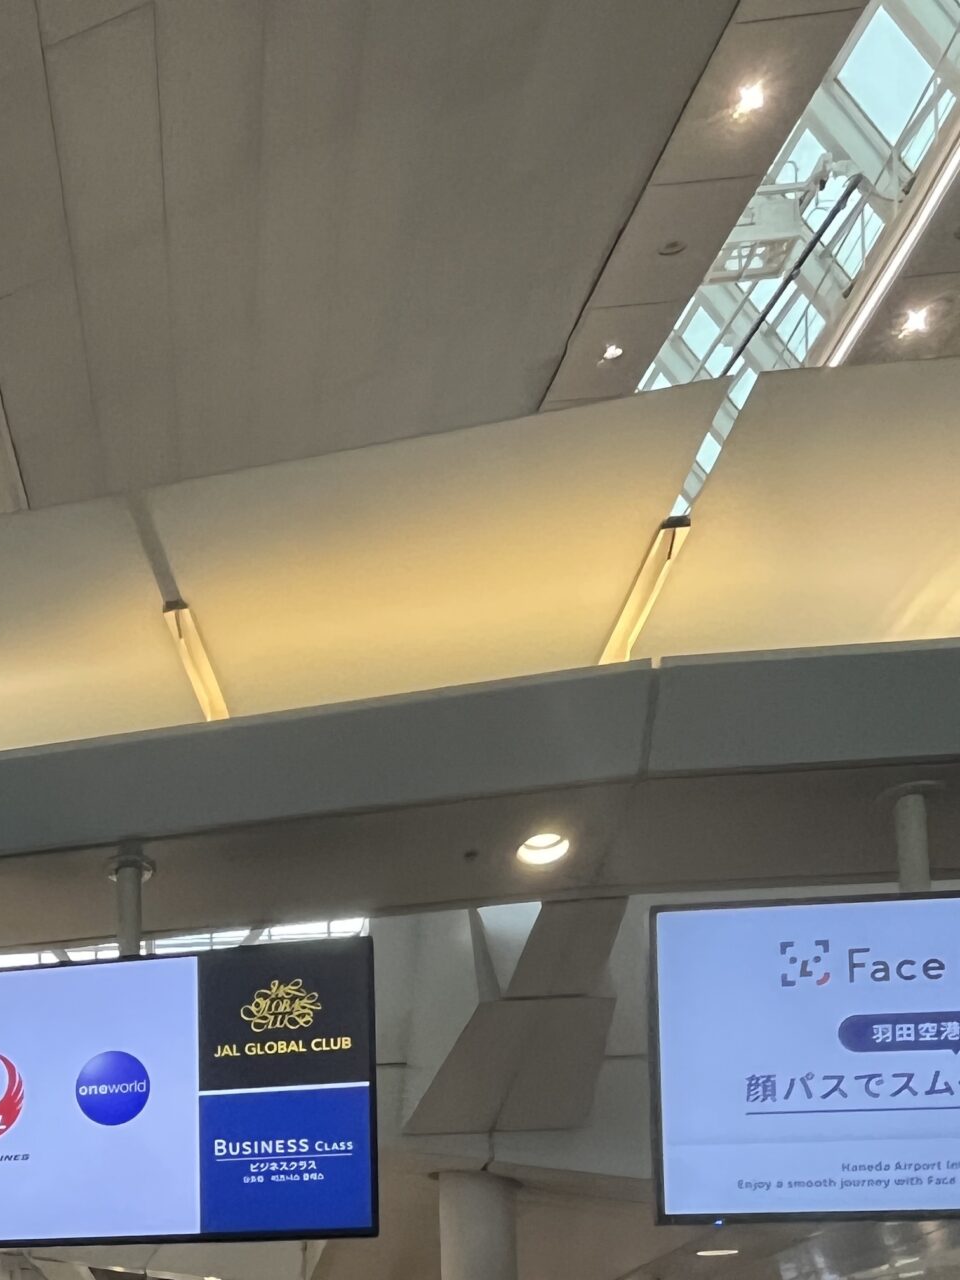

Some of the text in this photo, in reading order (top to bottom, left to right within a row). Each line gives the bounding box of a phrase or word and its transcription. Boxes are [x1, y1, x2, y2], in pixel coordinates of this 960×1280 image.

[847, 947, 946, 984] Face
[214, 1036, 352, 1058] JAL GLOBAL CLUB
[78, 1079, 147, 1096] oneworld
[745, 1069, 960, 1103] 顔パスでスム
[250, 1160, 317, 1172] ビジネスクラス
[841, 1161, 891, 1173] Haneda
[894, 1160, 941, 1174] Airport
[737, 1175, 956, 1192] Enjoy a smooth journey with Face
